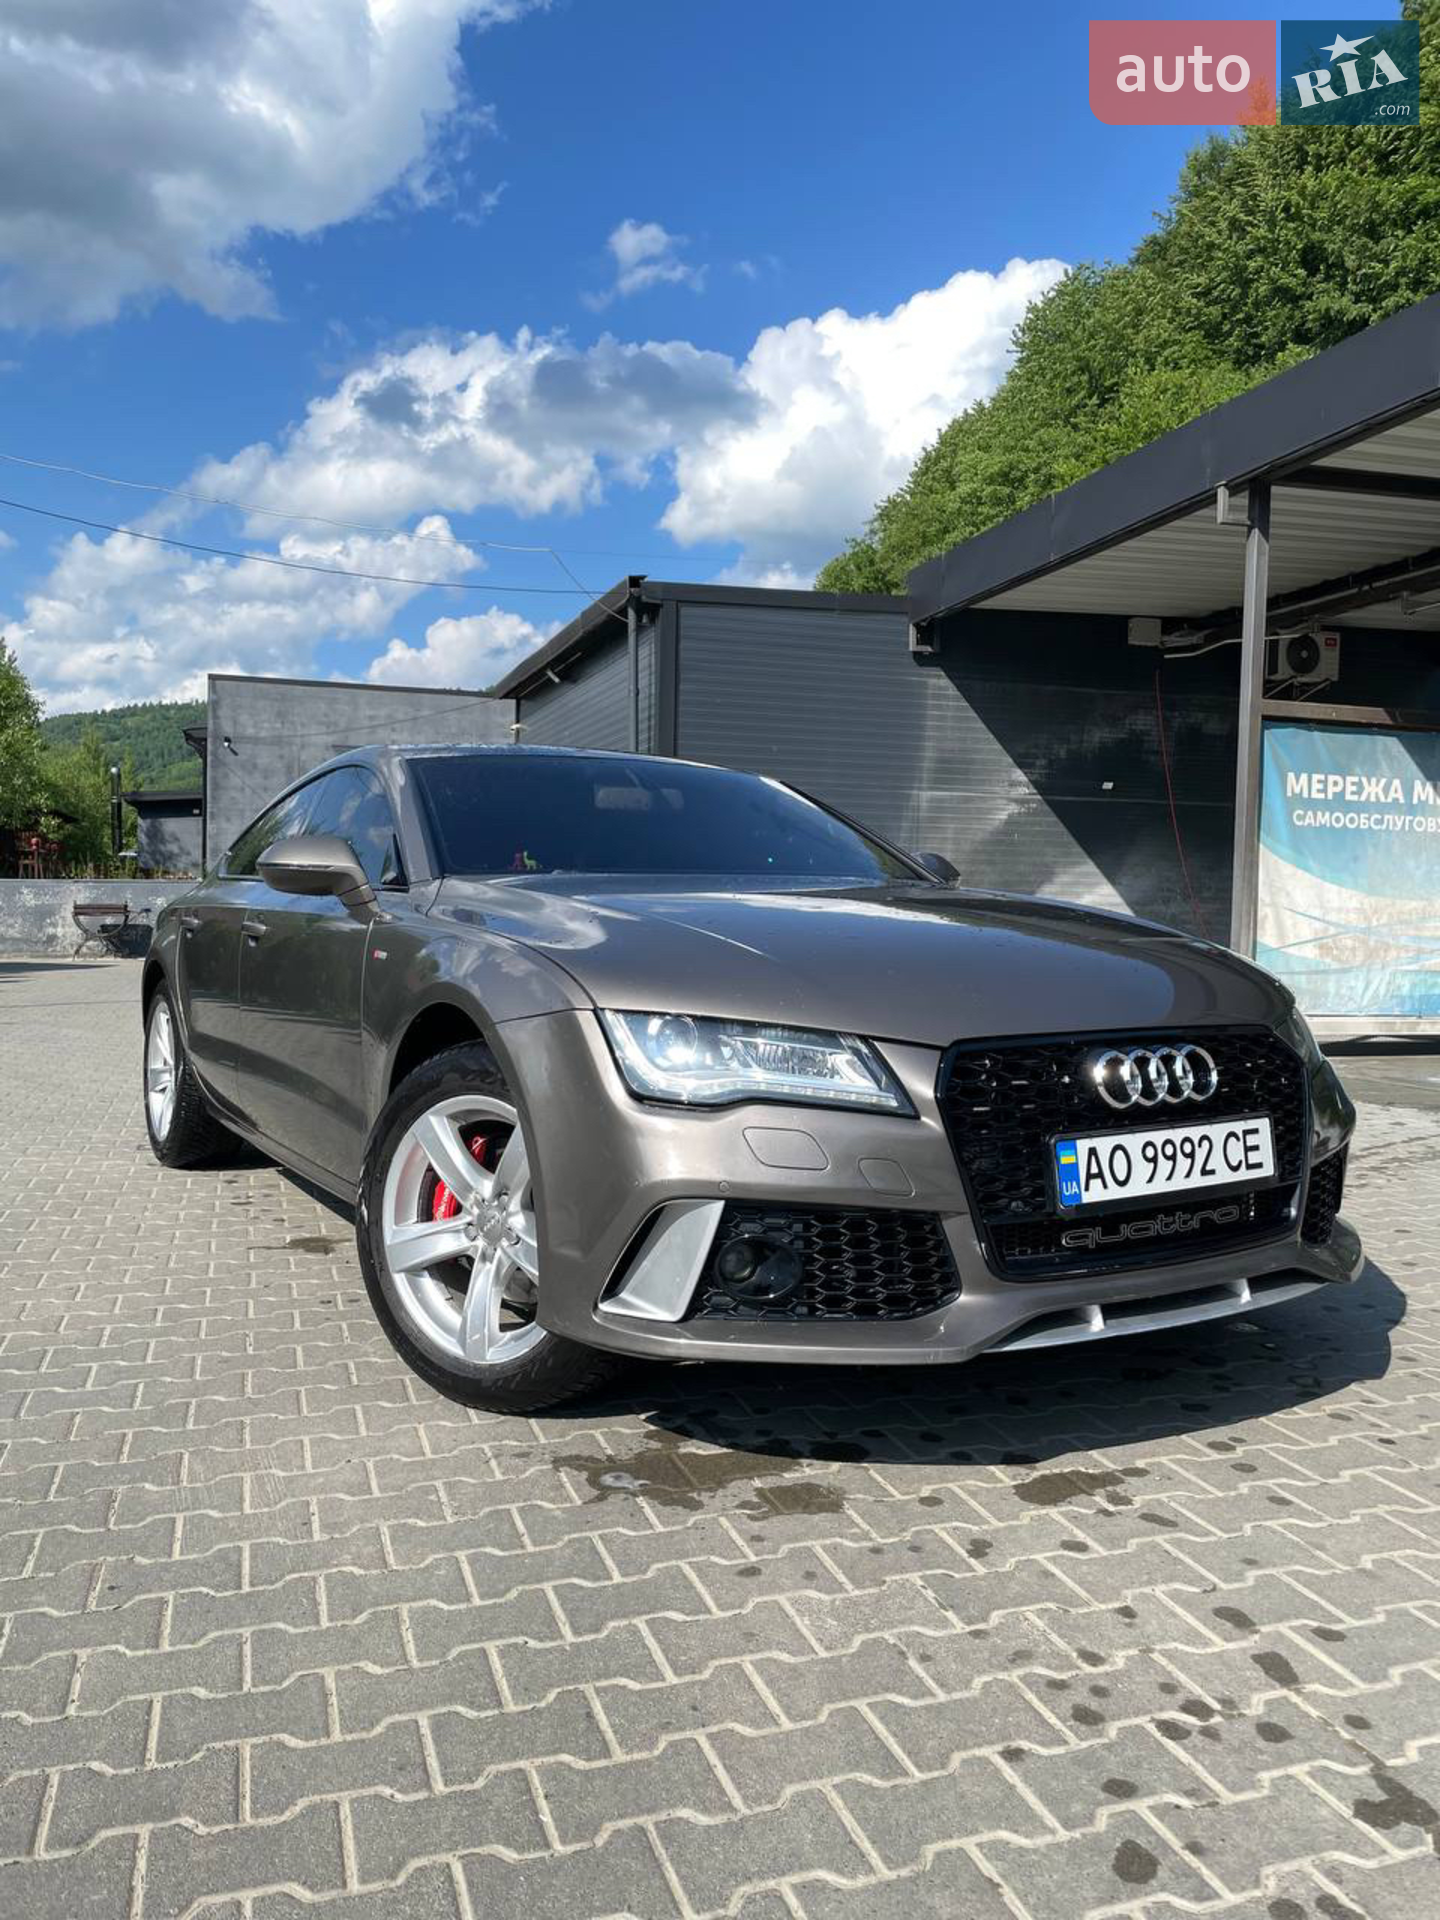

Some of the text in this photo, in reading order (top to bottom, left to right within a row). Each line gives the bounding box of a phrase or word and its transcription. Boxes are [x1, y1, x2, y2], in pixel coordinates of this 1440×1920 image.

[1285, 771, 1440, 805] МЕРЕЖА М
[1083, 1127, 1264, 1192] AO 9992 CE
[1062, 1180, 1080, 1196] UA
[1061, 1205, 1240, 1248] quattro
